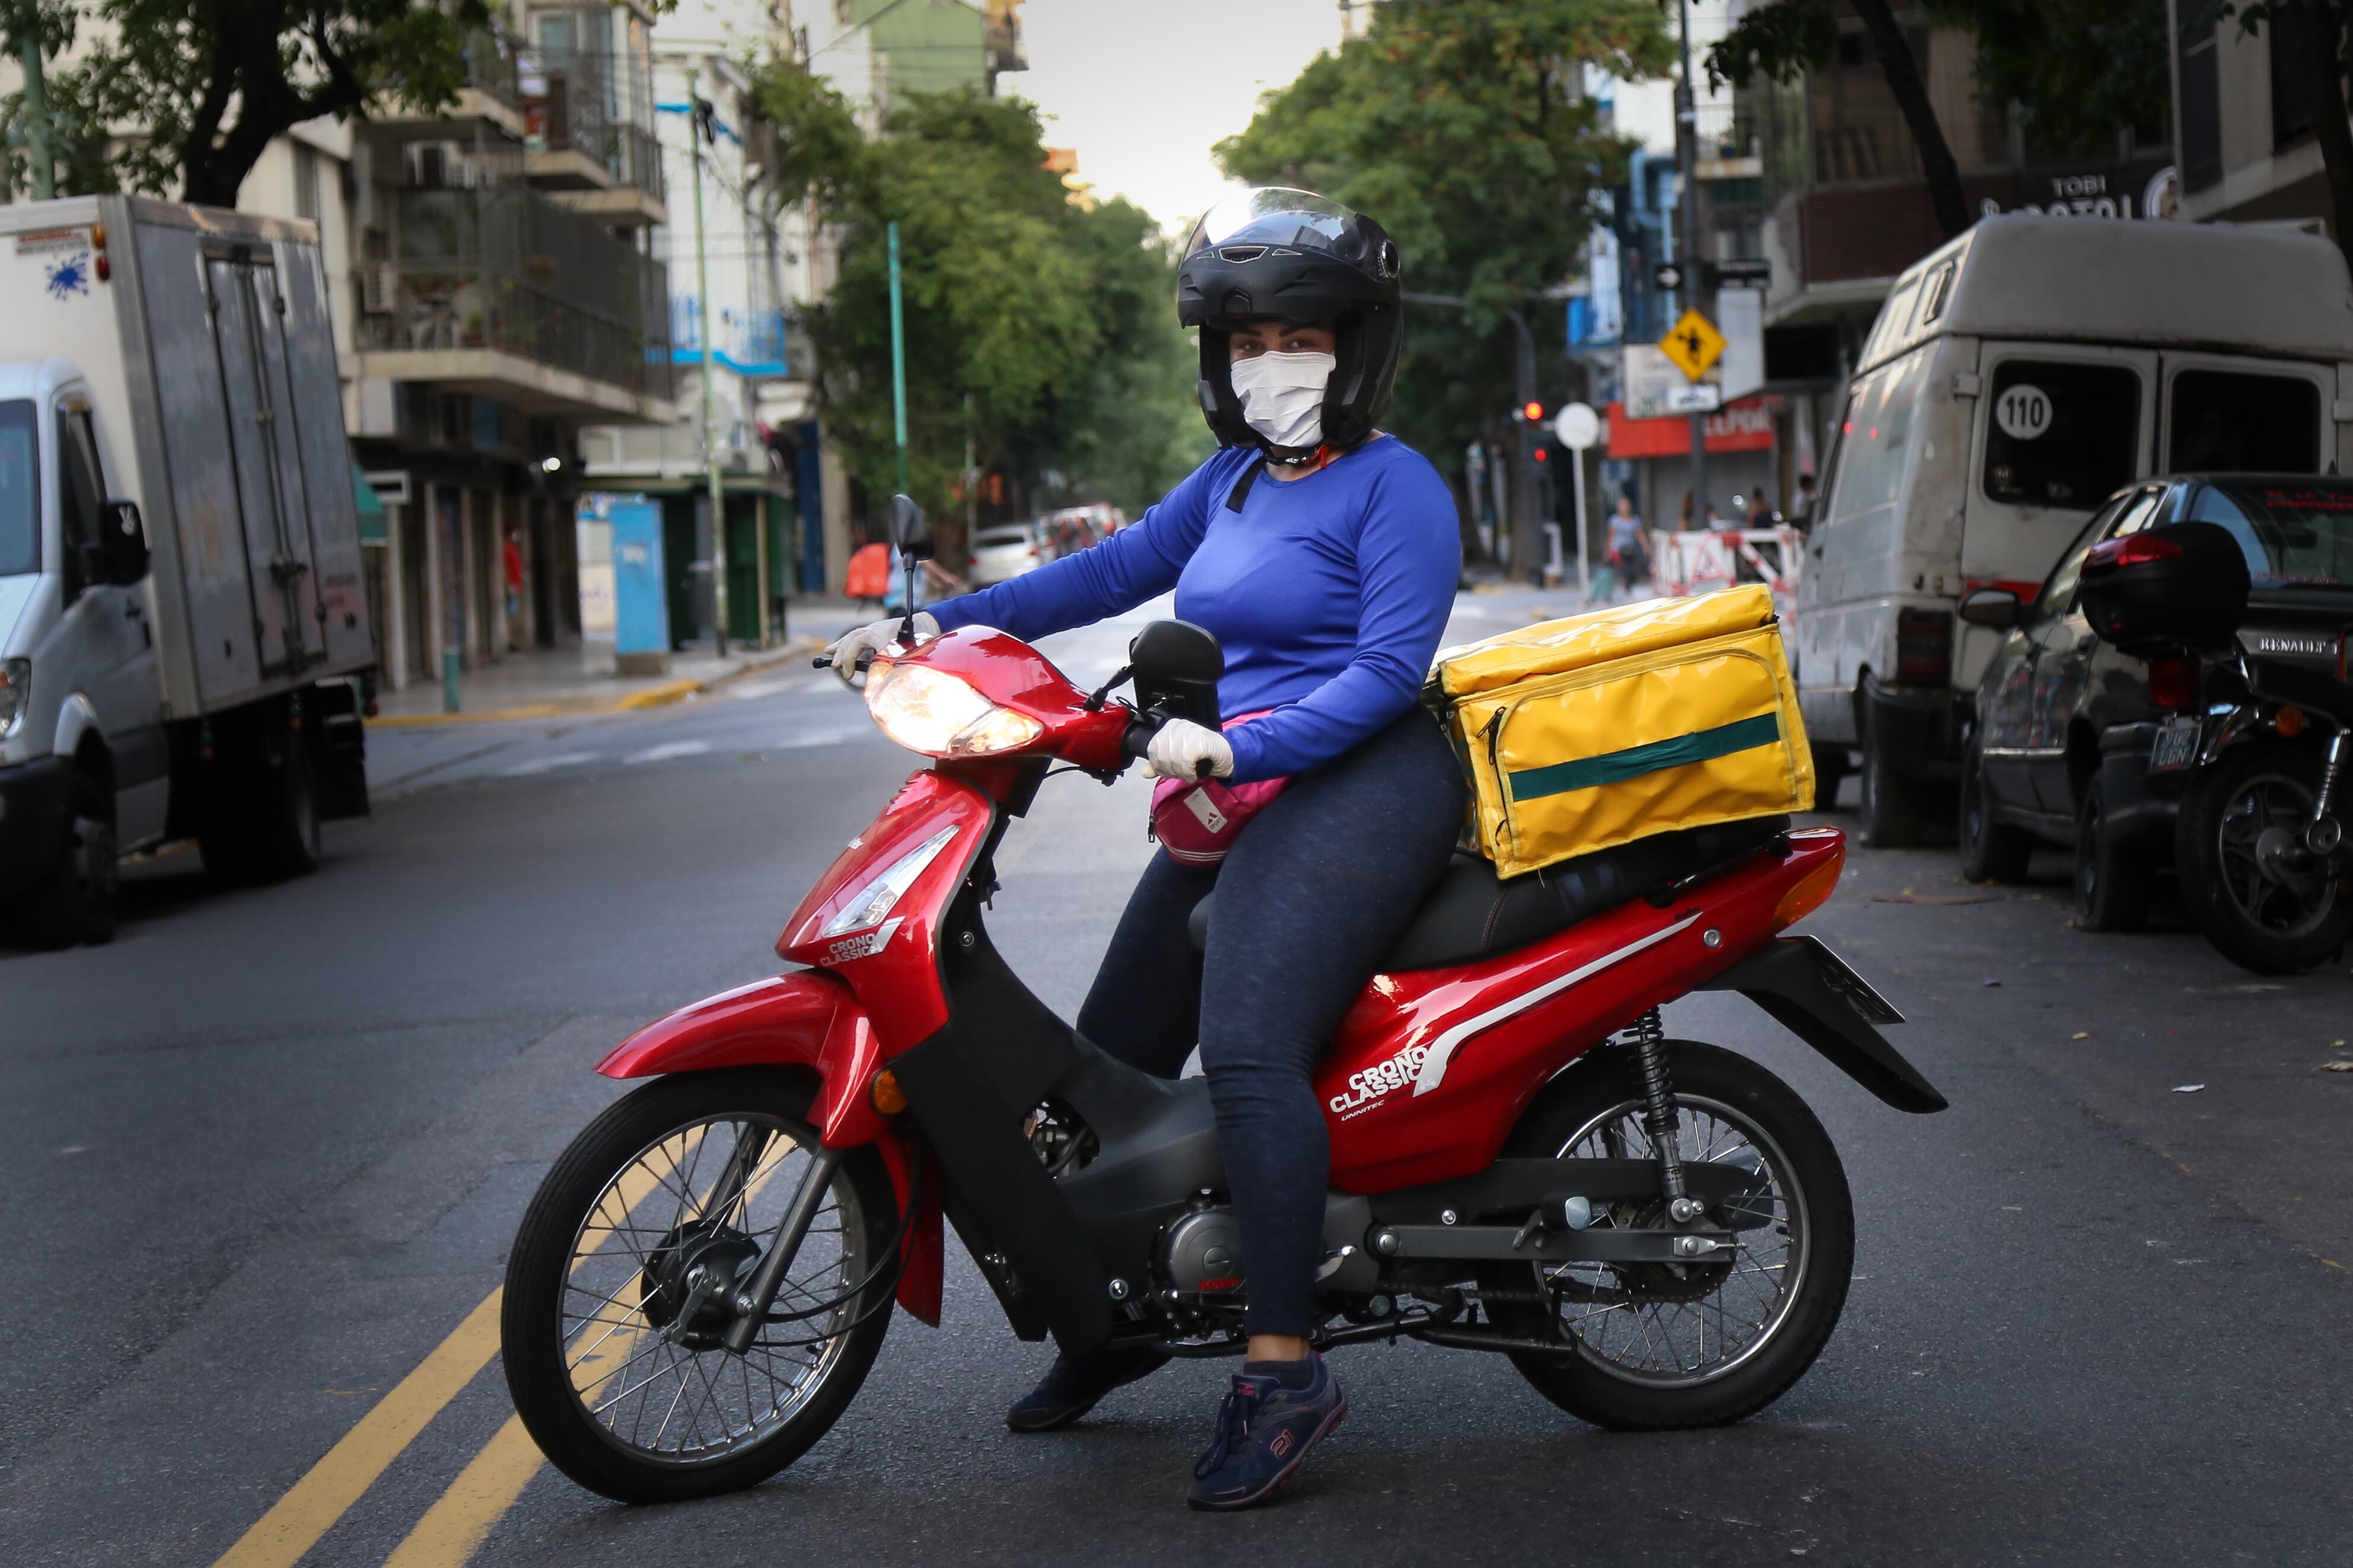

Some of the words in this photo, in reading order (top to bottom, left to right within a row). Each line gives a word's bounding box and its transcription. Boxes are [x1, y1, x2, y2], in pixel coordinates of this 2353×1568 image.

[2052, 174, 2106, 198] TOBI
[2006, 395, 2045, 428] 110
[2259, 636, 2326, 654] RENAULT
[1209, 817, 1222, 830] SPORT
[829, 933, 875, 954] CRONO
[820, 946, 870, 966] CLASSIC
[1348, 1047, 1428, 1090] CRONO
[1329, 1064, 1422, 1113] CLASSIC
[1341, 1099, 1384, 1121] UNNITEC
